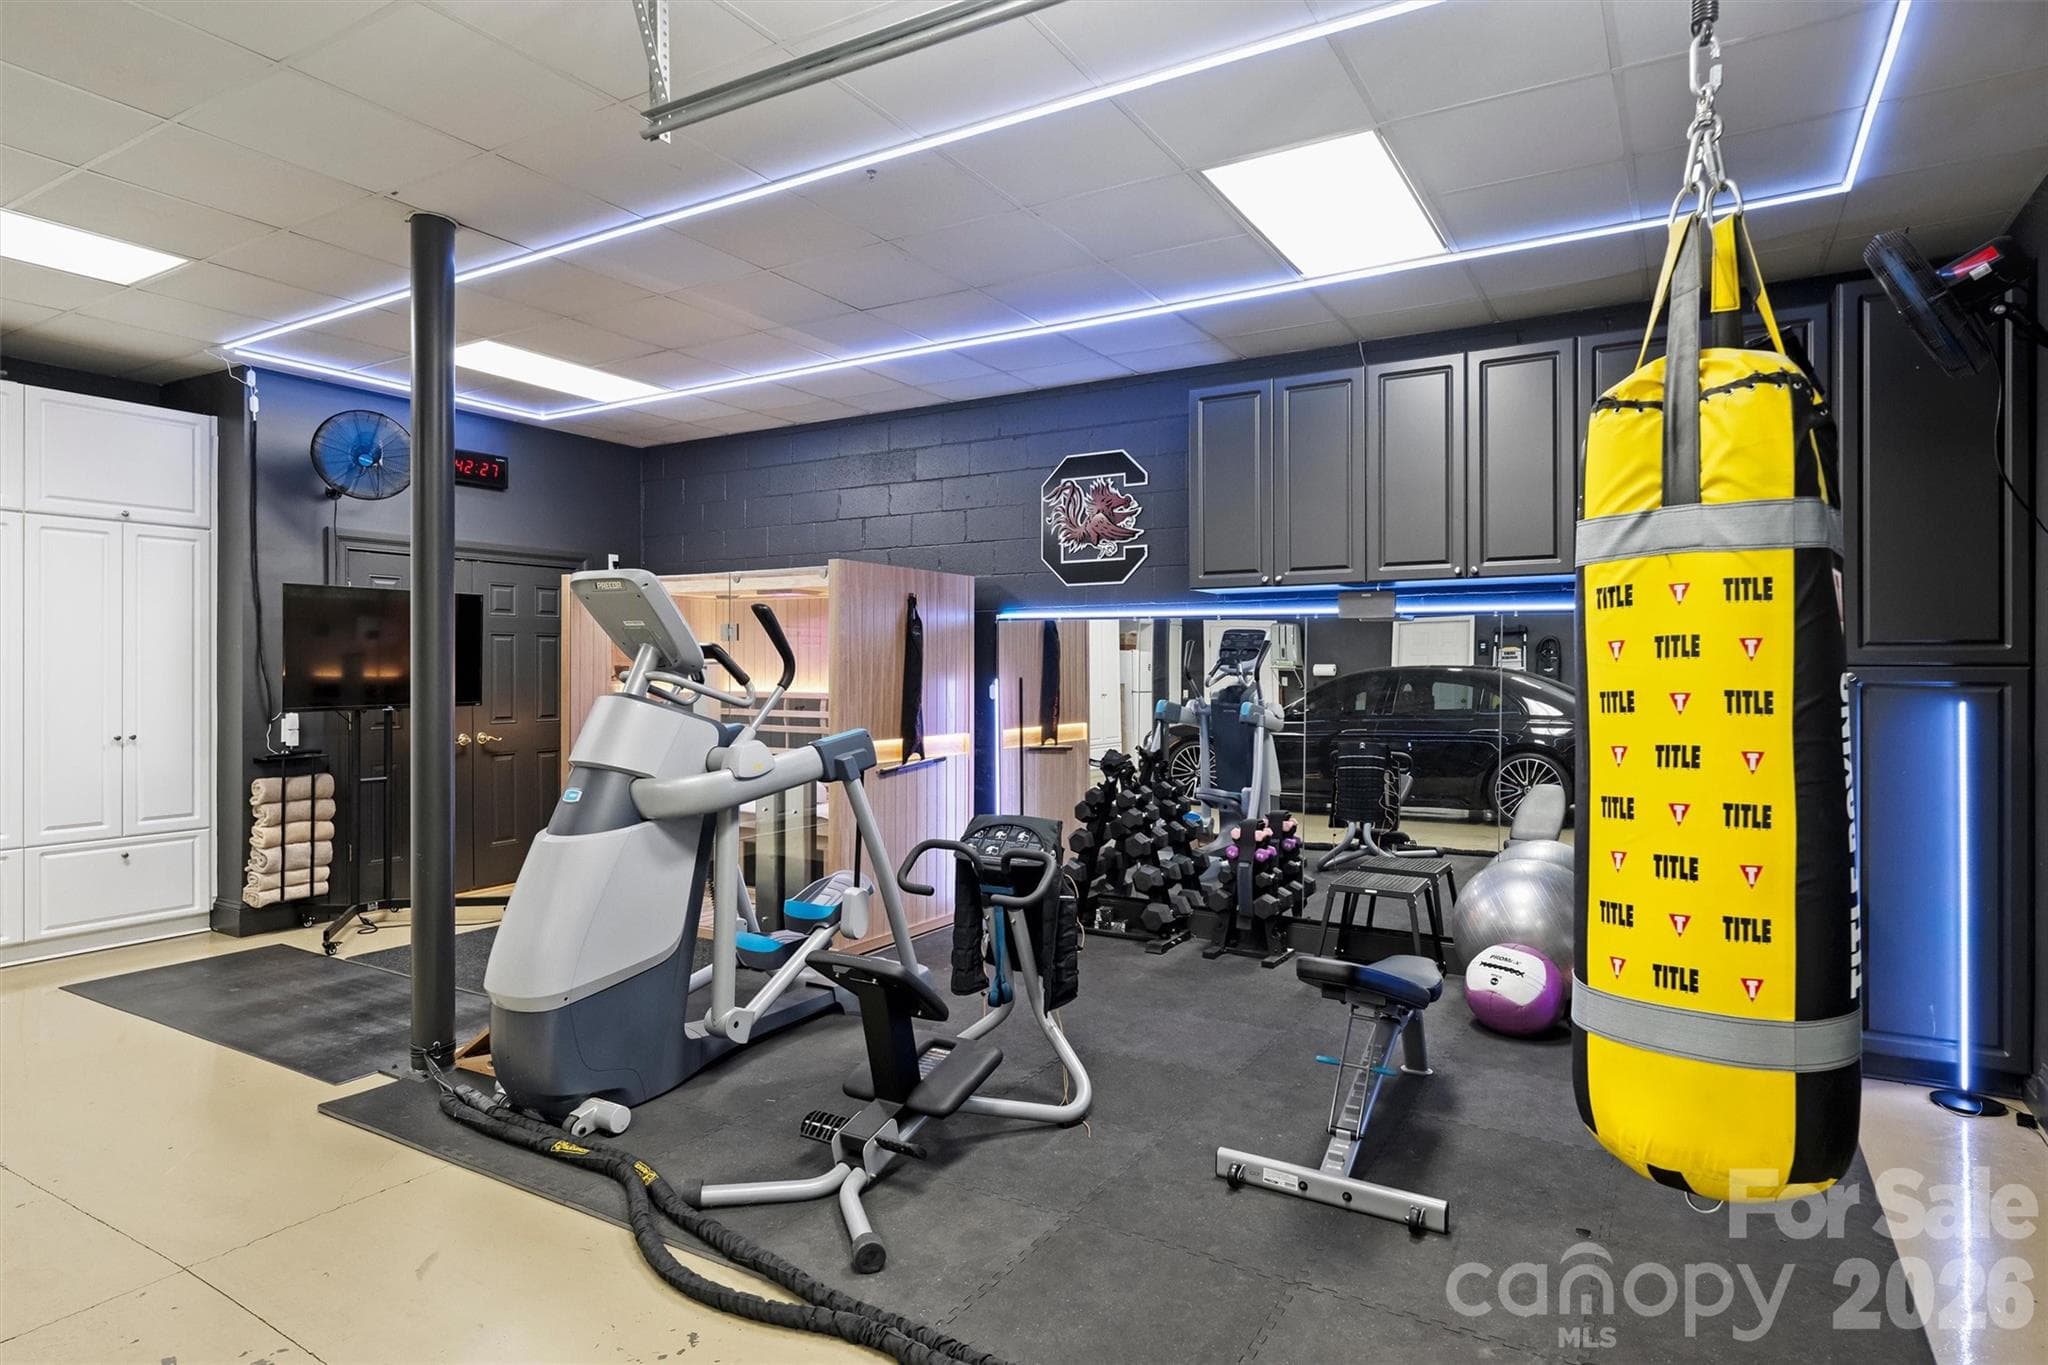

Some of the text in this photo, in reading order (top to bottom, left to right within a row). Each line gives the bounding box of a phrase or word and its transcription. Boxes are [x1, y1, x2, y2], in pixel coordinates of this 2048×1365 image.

[1596, 584, 1633, 610] TITLE
[1723, 576, 1773, 601] TITLE
[1654, 634, 1700, 659] TITLE
[1599, 690, 1635, 713] TITLE
[1724, 689, 1774, 715] TITLE
[1655, 744, 1701, 769] TITLE
[1601, 796, 1634, 820] TITLE
[1722, 802, 1772, 829] TITLE
[1653, 854, 1699, 881] TITLE
[1599, 900, 1634, 928] TITLE
[1722, 915, 1772, 944] TITLE
[1652, 963, 1699, 993] TITLE
